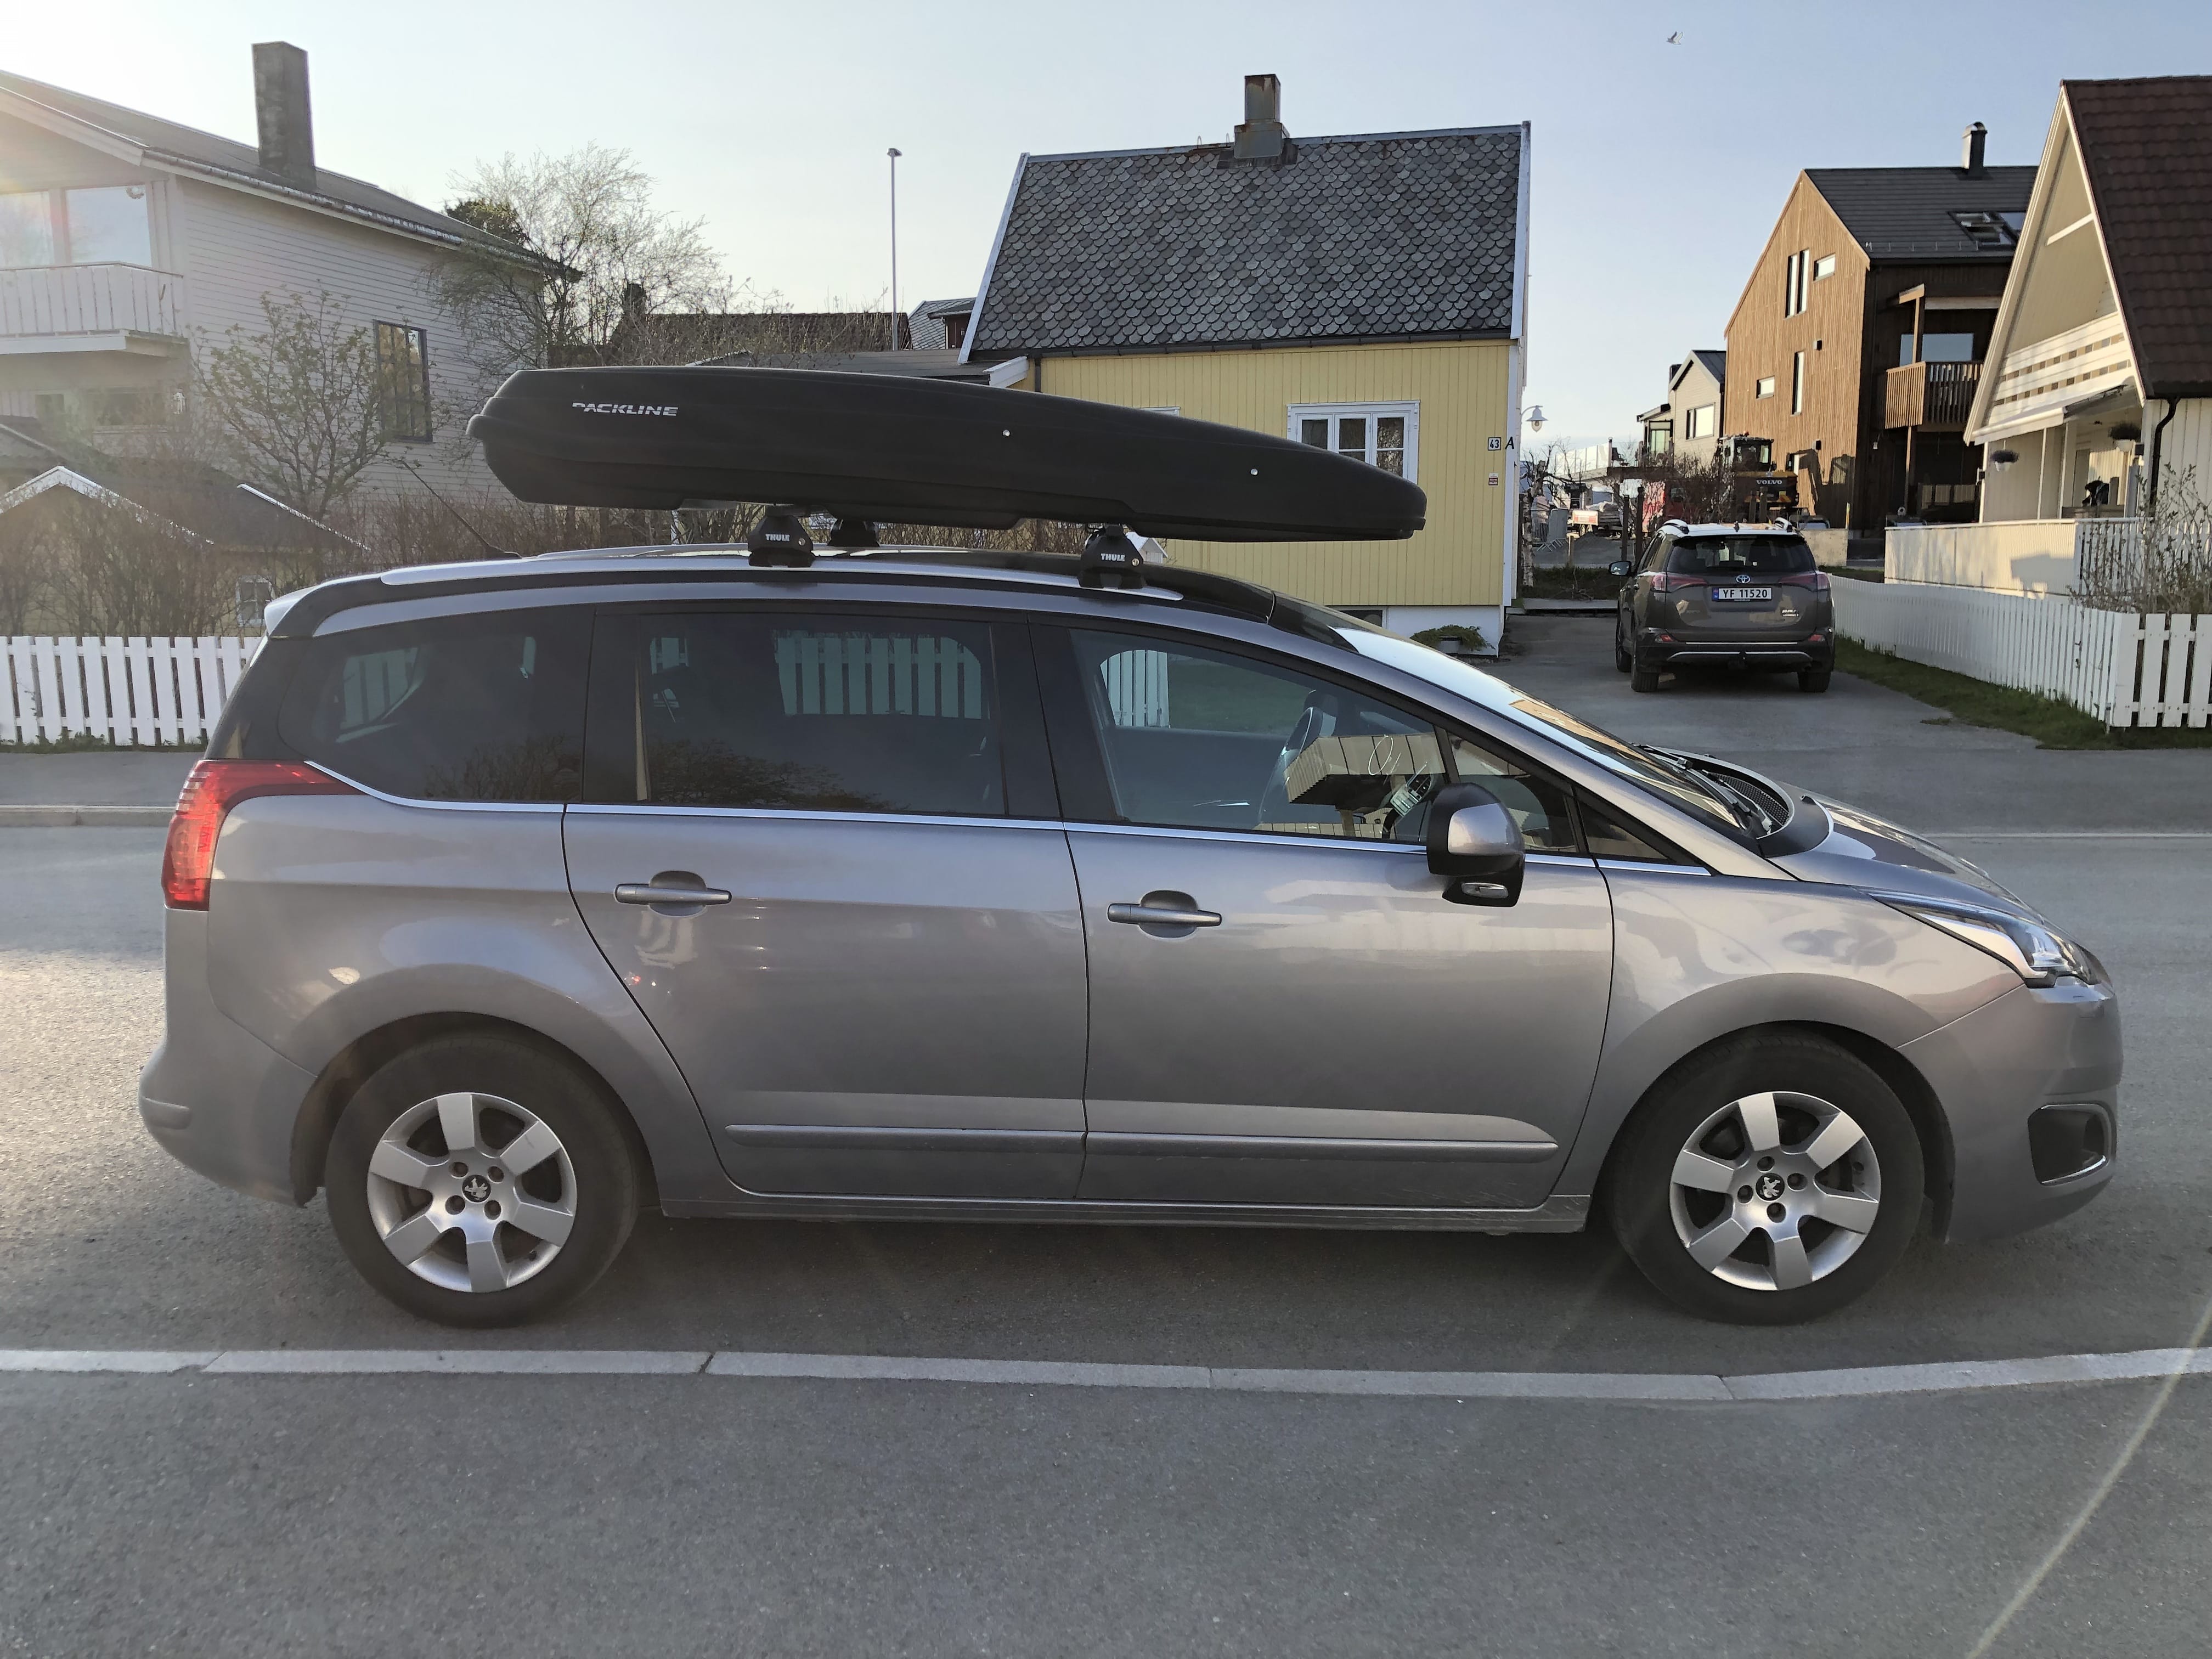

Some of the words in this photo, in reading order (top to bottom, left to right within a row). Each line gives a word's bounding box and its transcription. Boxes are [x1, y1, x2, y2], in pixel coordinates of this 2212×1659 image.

[1489, 439, 1499, 449] 43
[1505, 436, 1515, 449] A
[1101, 553, 1125, 562] THULE
[1723, 589, 1735, 598] YF
[1739, 589, 1768, 598] 11520
